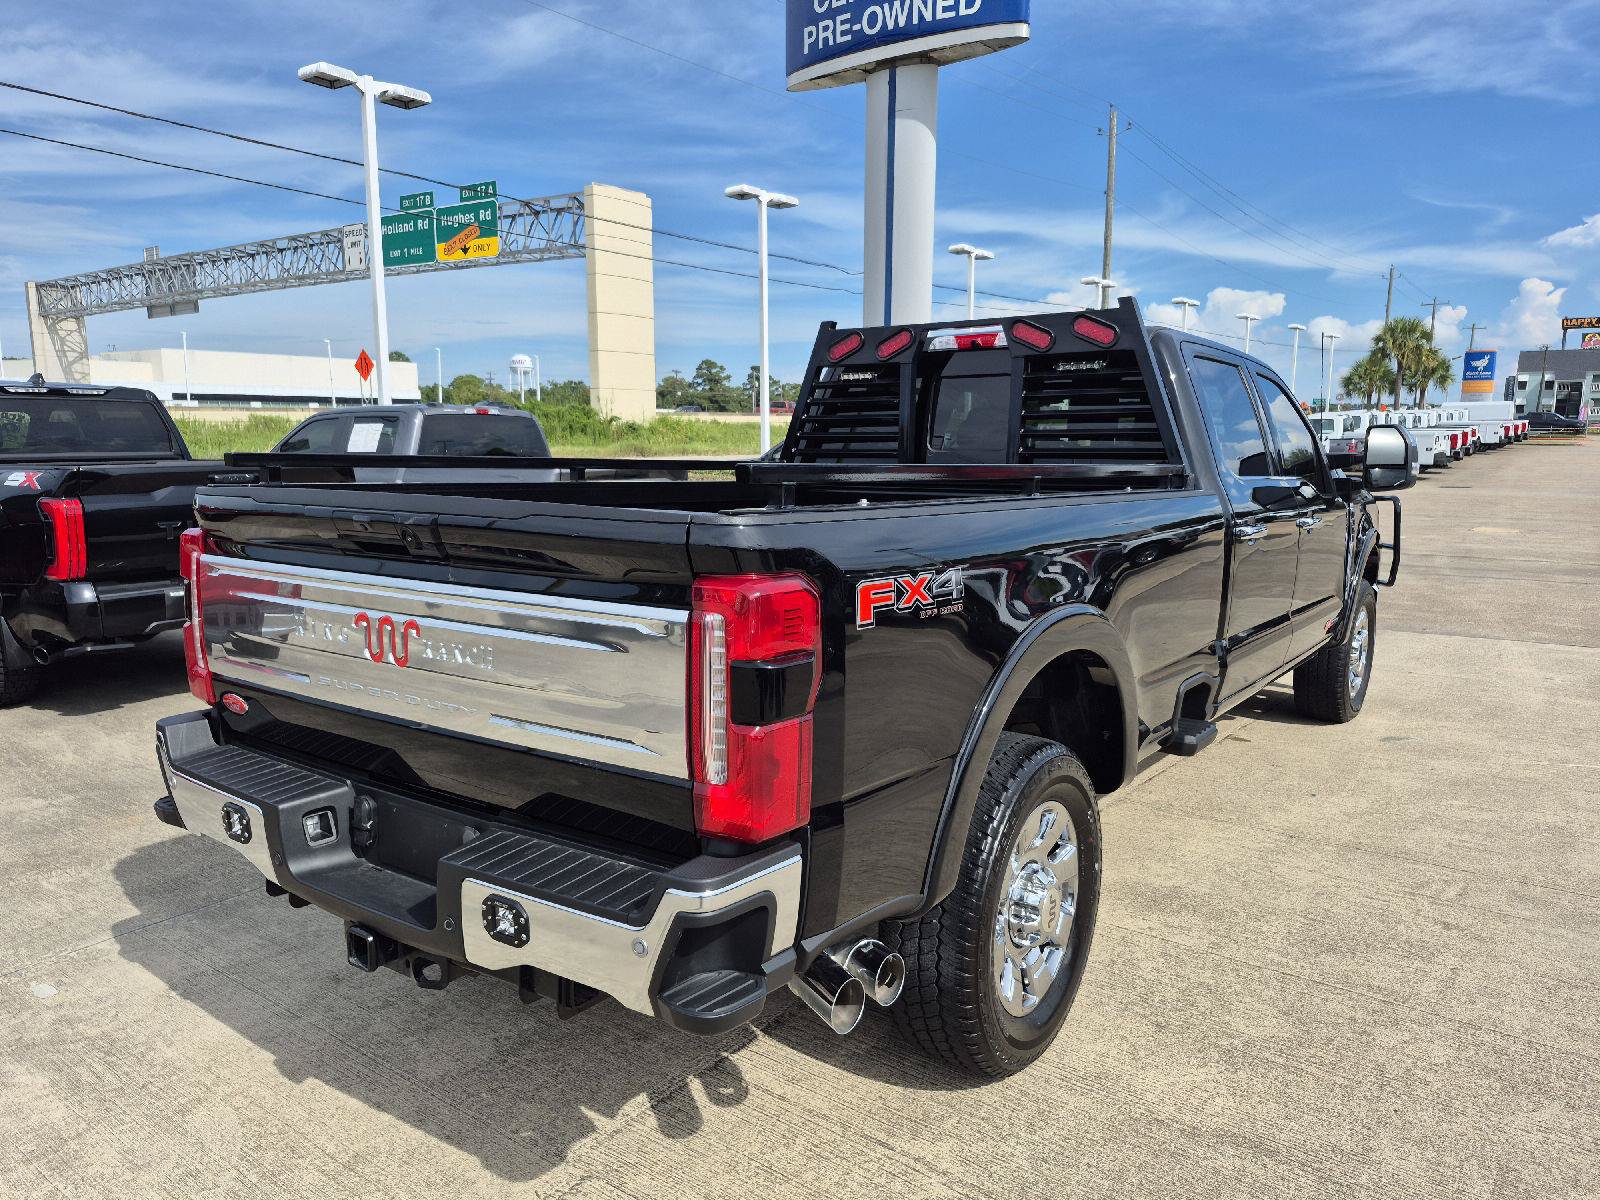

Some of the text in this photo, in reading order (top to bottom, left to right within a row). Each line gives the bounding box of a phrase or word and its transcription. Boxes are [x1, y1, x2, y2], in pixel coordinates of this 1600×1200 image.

[803, 0, 982, 54] PRE-OWNED
[462, 190, 474, 198] EXIT
[477, 186, 486, 197] 17
[403, 194, 431, 207] EXIT 17 B
[441, 208, 492, 227] Hughes Rd
[382, 218, 429, 235] Holland Rd
[345, 229, 363, 238] SPEED
[404, 248, 408, 258] 1
[410, 247, 423, 255] MILE
[473, 244, 491, 252] ONLY
[1563, 317, 1598, 326] HAPPY
[856, 567, 964, 630] FX4
